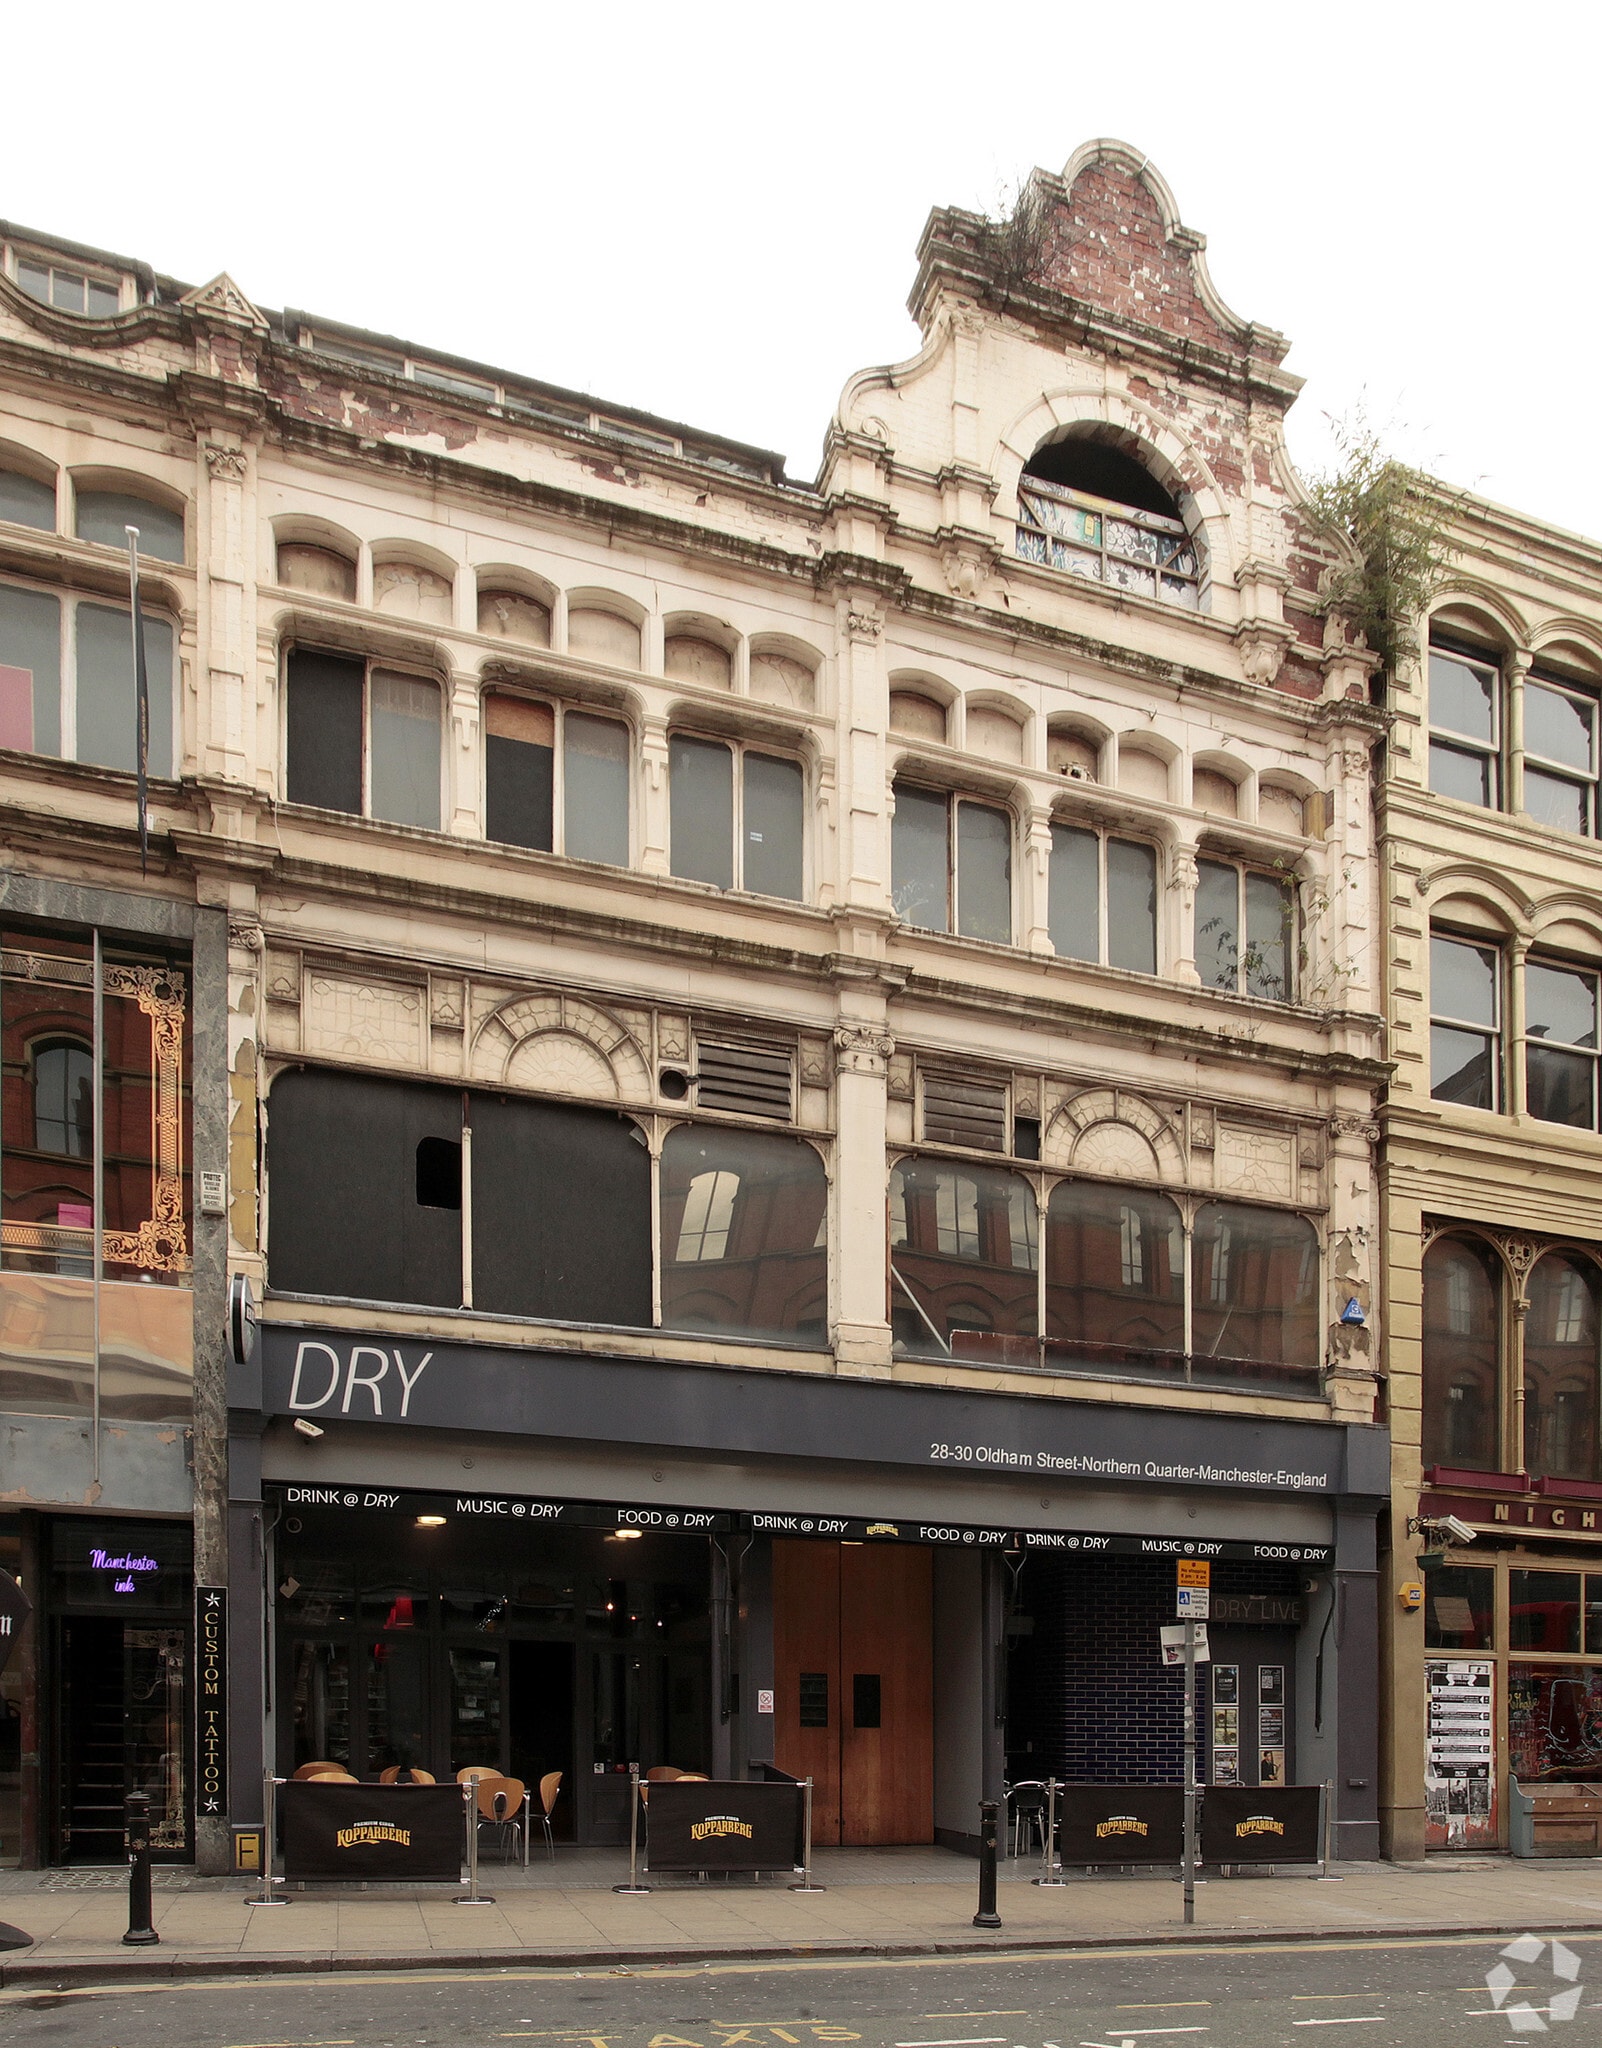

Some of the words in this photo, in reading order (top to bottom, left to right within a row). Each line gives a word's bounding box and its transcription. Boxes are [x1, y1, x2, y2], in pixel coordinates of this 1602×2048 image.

[289, 1342, 433, 1417] DRY
[930, 1443, 972, 1462] 28-30
[975, 1446, 1032, 1467] Oldham
[287, 1487, 340, 1504] DRINK
[343, 1493, 359, 1507] @
[363, 1493, 400, 1508] DRY
[456, 1499, 508, 1514] MUSIC
[511, 1503, 526, 1517] @
[530, 1503, 564, 1518] DRY
[617, 1509, 662, 1525] FOOD
[665, 1513, 679, 1527] @
[683, 1513, 715, 1527] DRY
[752, 1514, 798, 1530] DRINK
[800, 1519, 814, 1532] @
[818, 1519, 849, 1533] DRY
[919, 1526, 960, 1541] FOOD
[962, 1531, 975, 1543] @
[978, 1531, 1008, 1544] DRY
[1026, 1533, 1066, 1547] DRINK
[1067, 1537, 1080, 1549] @
[1082, 1537, 1110, 1550] DRY
[1141, 1540, 1181, 1553] MUSIC
[1183, 1542, 1195, 1554] @
[1197, 1542, 1223, 1555] DRY
[1254, 1545, 1288, 1558] FOOD
[1290, 1549, 1301, 1560] @
[1303, 1549, 1328, 1560] DRY
[89, 1549, 159, 1571] Manchester
[114, 1574, 135, 1593] ink
[1215, 1599, 1252, 1619] DRY
[1261, 1601, 1301, 1620] LIVE
[204, 1612, 220, 1695] CUSTOM
[204, 1710, 220, 1793] TATTOO
[336, 1826, 411, 1848] KOPPARBERG
[691, 1820, 753, 1840] KOPPARBERG
[1096, 1819, 1148, 1838] KOPPARBERG
[1236, 1819, 1284, 1838] KOPPARBERG
